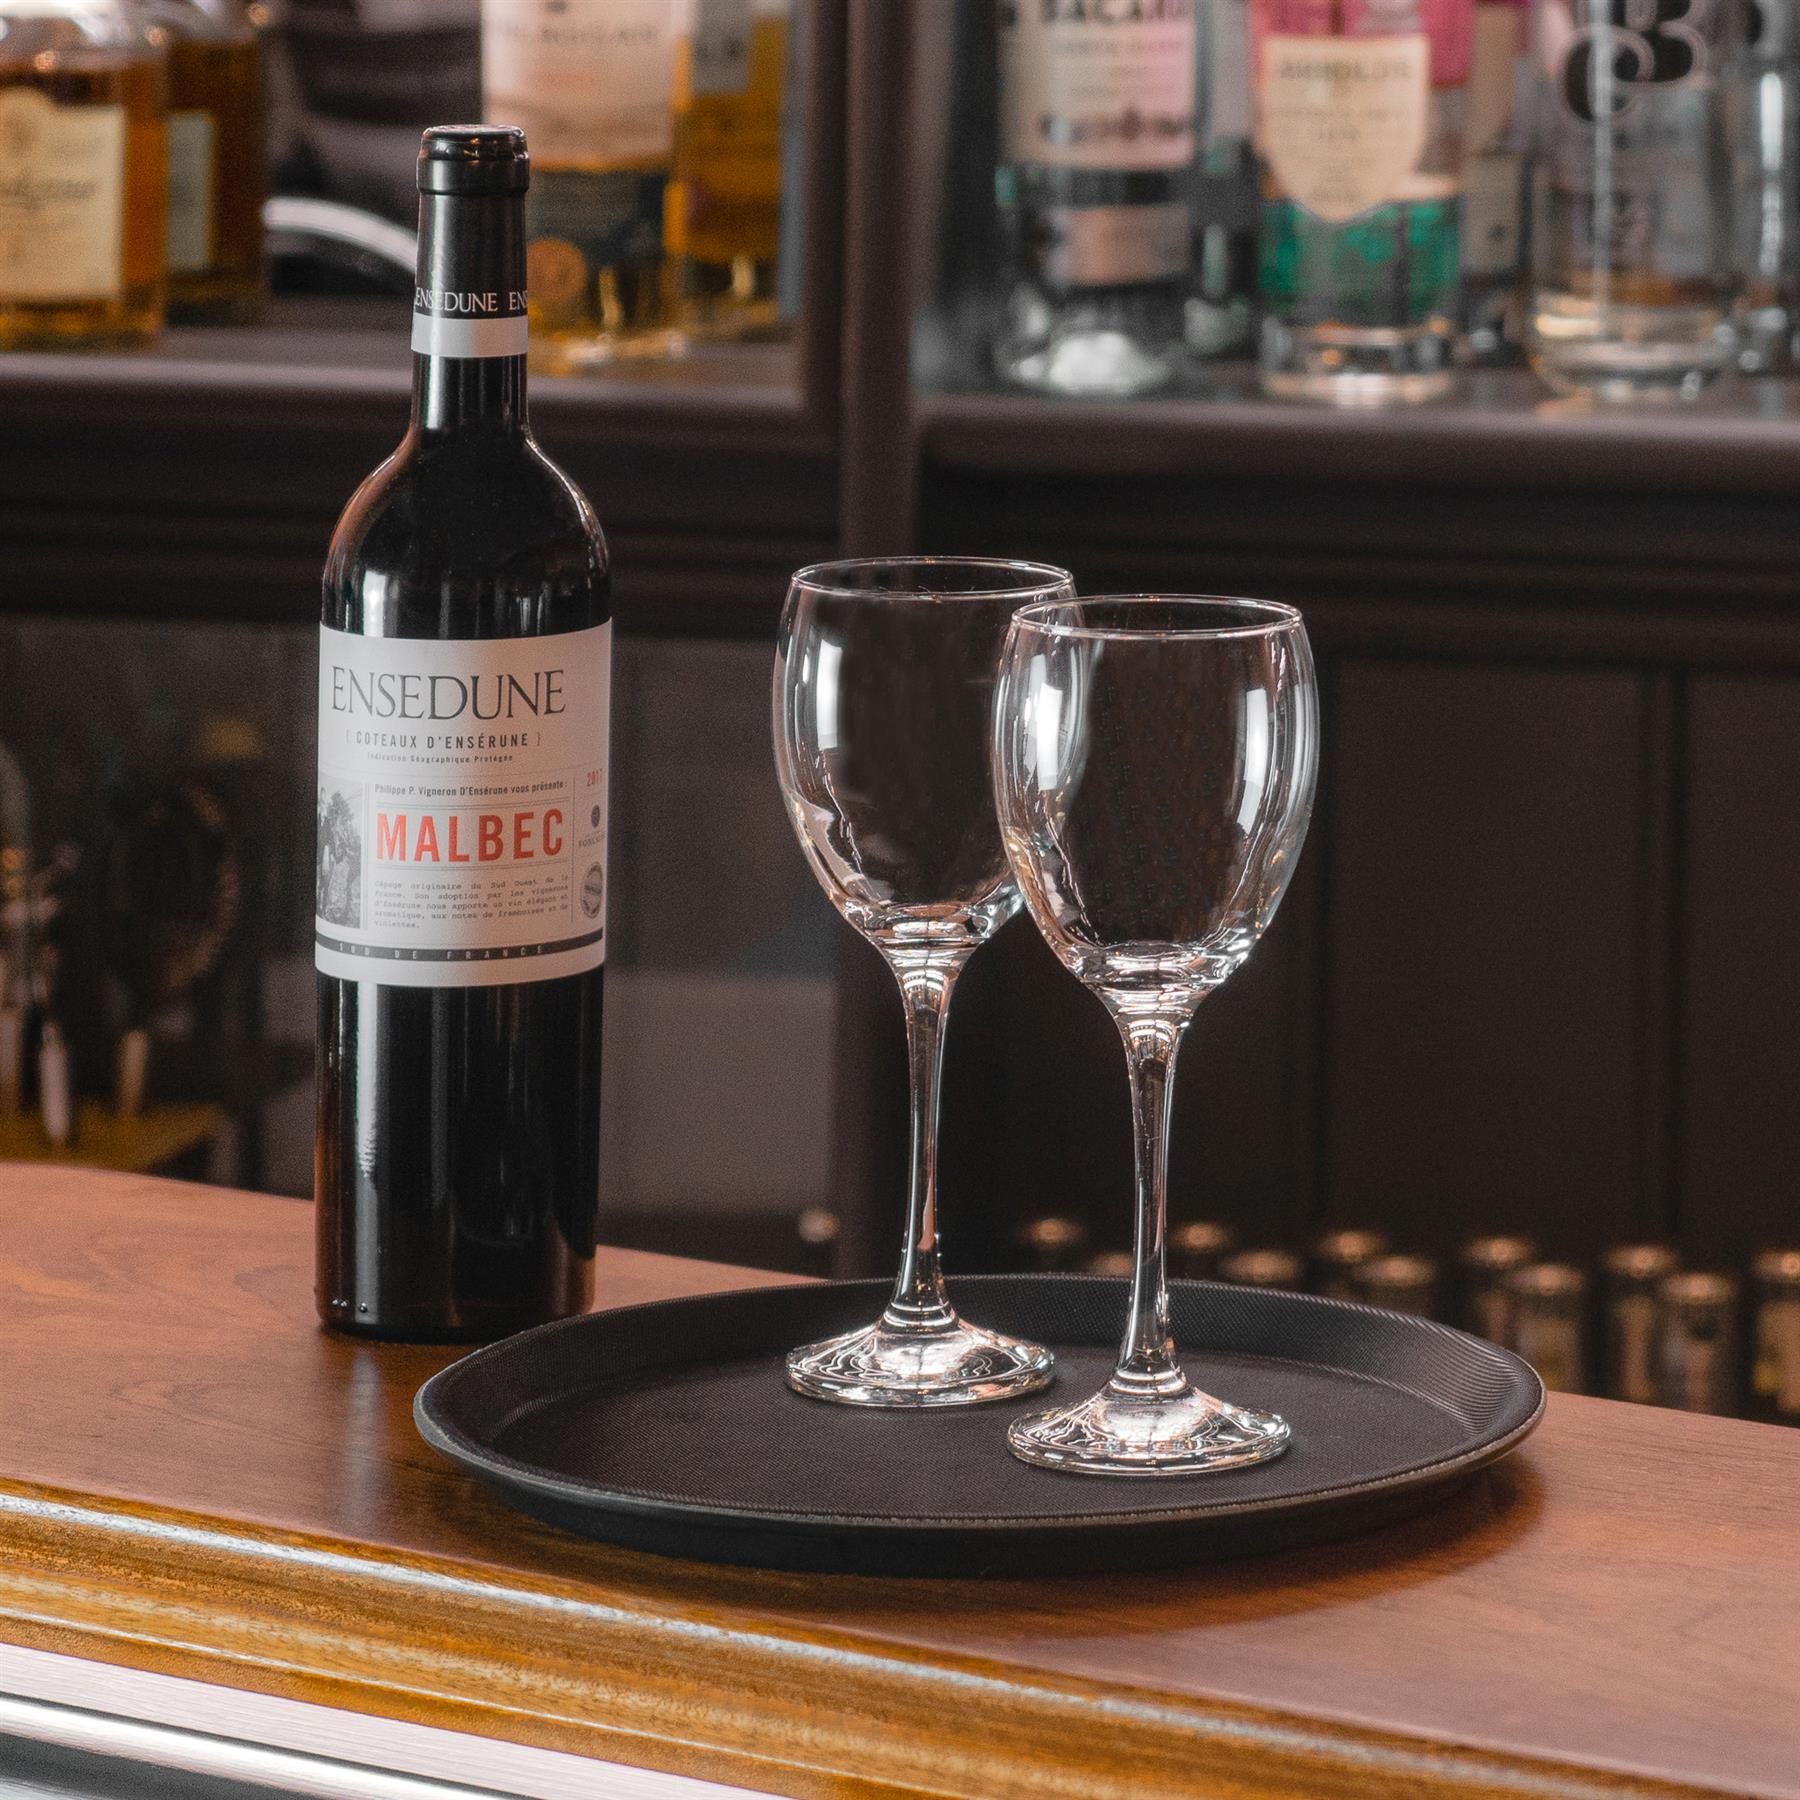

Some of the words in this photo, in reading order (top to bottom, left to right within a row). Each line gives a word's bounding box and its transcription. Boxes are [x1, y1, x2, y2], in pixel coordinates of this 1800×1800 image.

[332, 665, 567, 721] ENSEDUNE
[356, 730, 417, 749] COTEAUX
[427, 731, 528, 750] D'ENSÉRUNE
[374, 783, 406, 796] Philippe
[409, 786, 416, 796] P.
[419, 786, 457, 797] Vigneron
[459, 785, 509, 797] D'Ensérune
[511, 784, 530, 794] vous
[376, 808, 564, 863] MALBEC
[394, 949, 418, 960] DE
[446, 944, 543, 961] FRANCE
